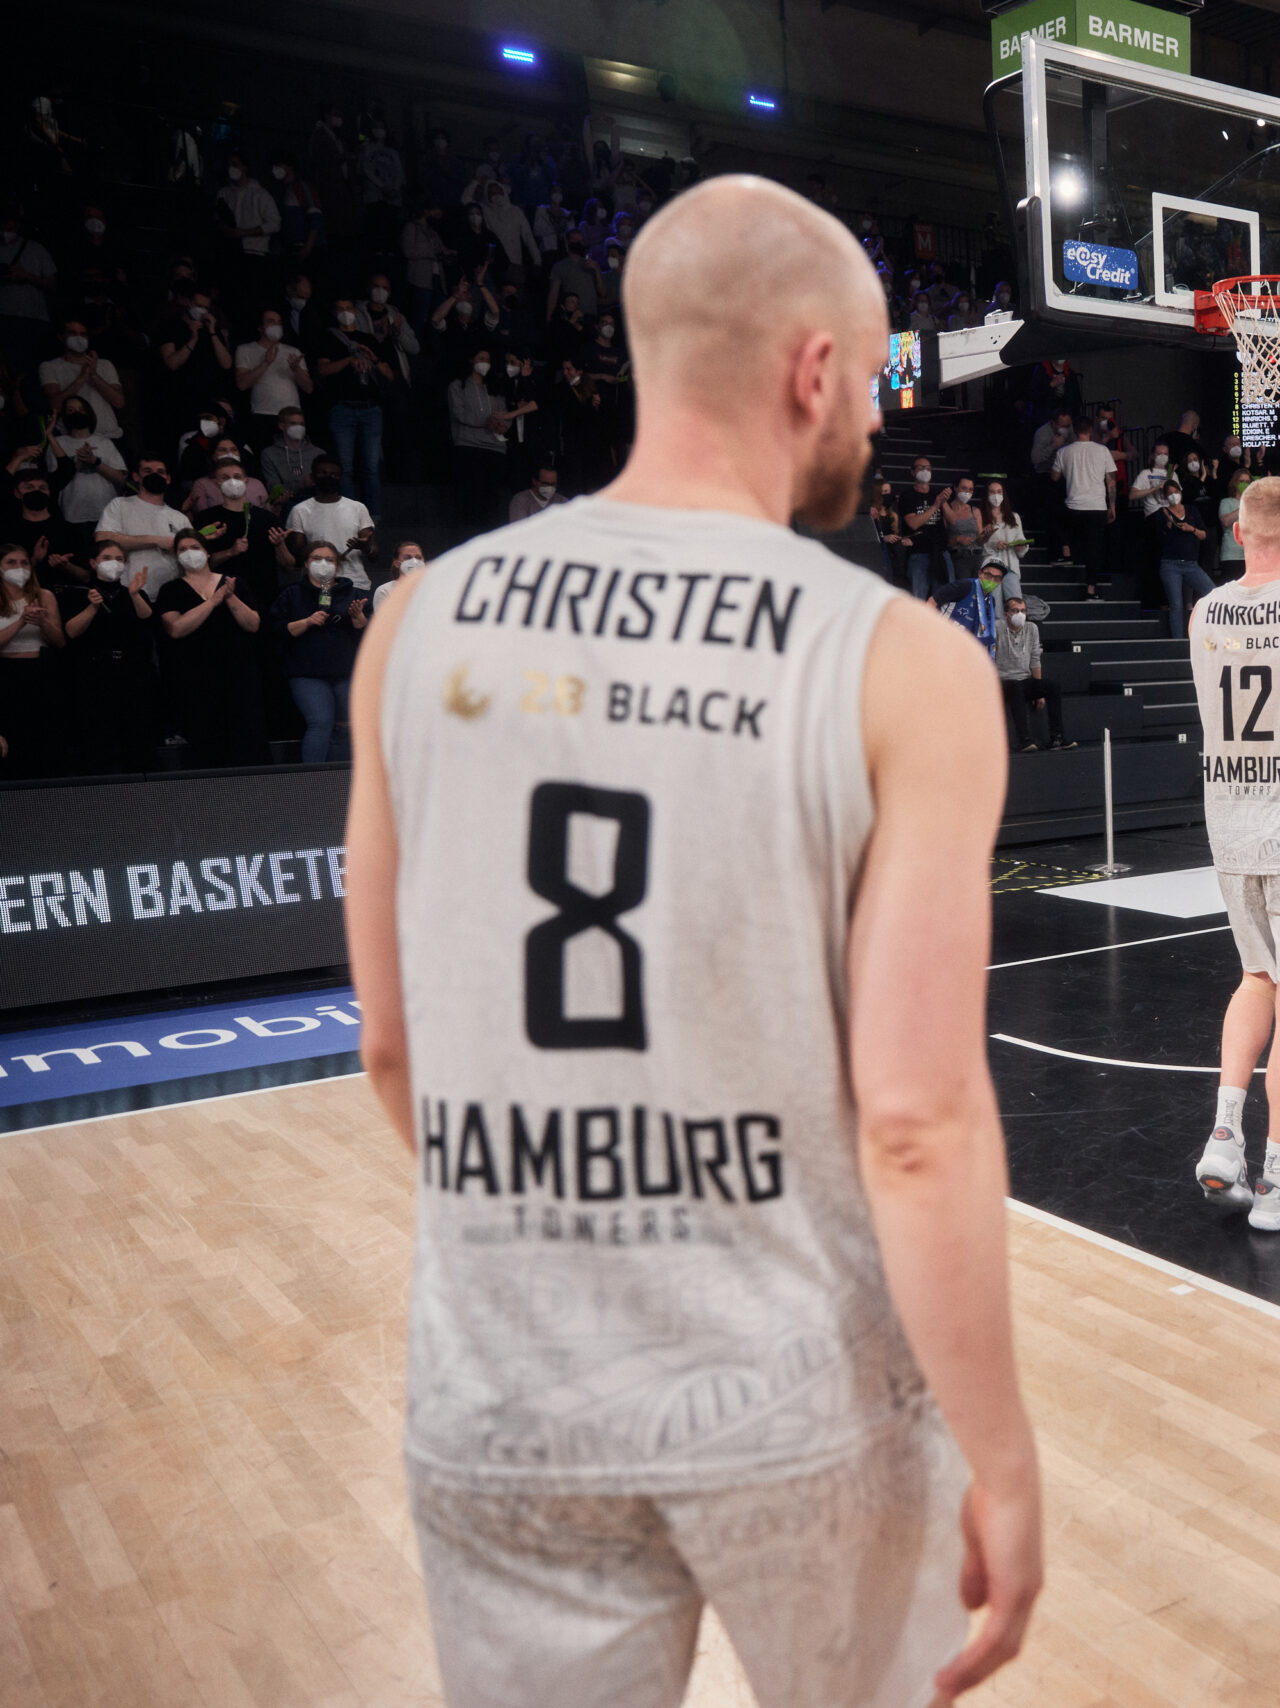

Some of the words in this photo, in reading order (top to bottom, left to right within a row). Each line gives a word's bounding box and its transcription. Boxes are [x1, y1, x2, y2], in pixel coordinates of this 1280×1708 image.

[1088, 15, 1179, 58] BARMER
[918, 232, 931, 251] M
[454, 555, 802, 655] CHRISTEN
[519, 670, 587, 716] 28
[607, 682, 767, 738] BLACK
[1219, 665, 1275, 742] 12
[1228, 785, 1271, 796] TOWERS
[525, 780, 650, 1053] 8
[0, 1001, 360, 1078] mobi
[421, 1096, 784, 1203] HAMBURG
[515, 1205, 691, 1246] TOWERS
